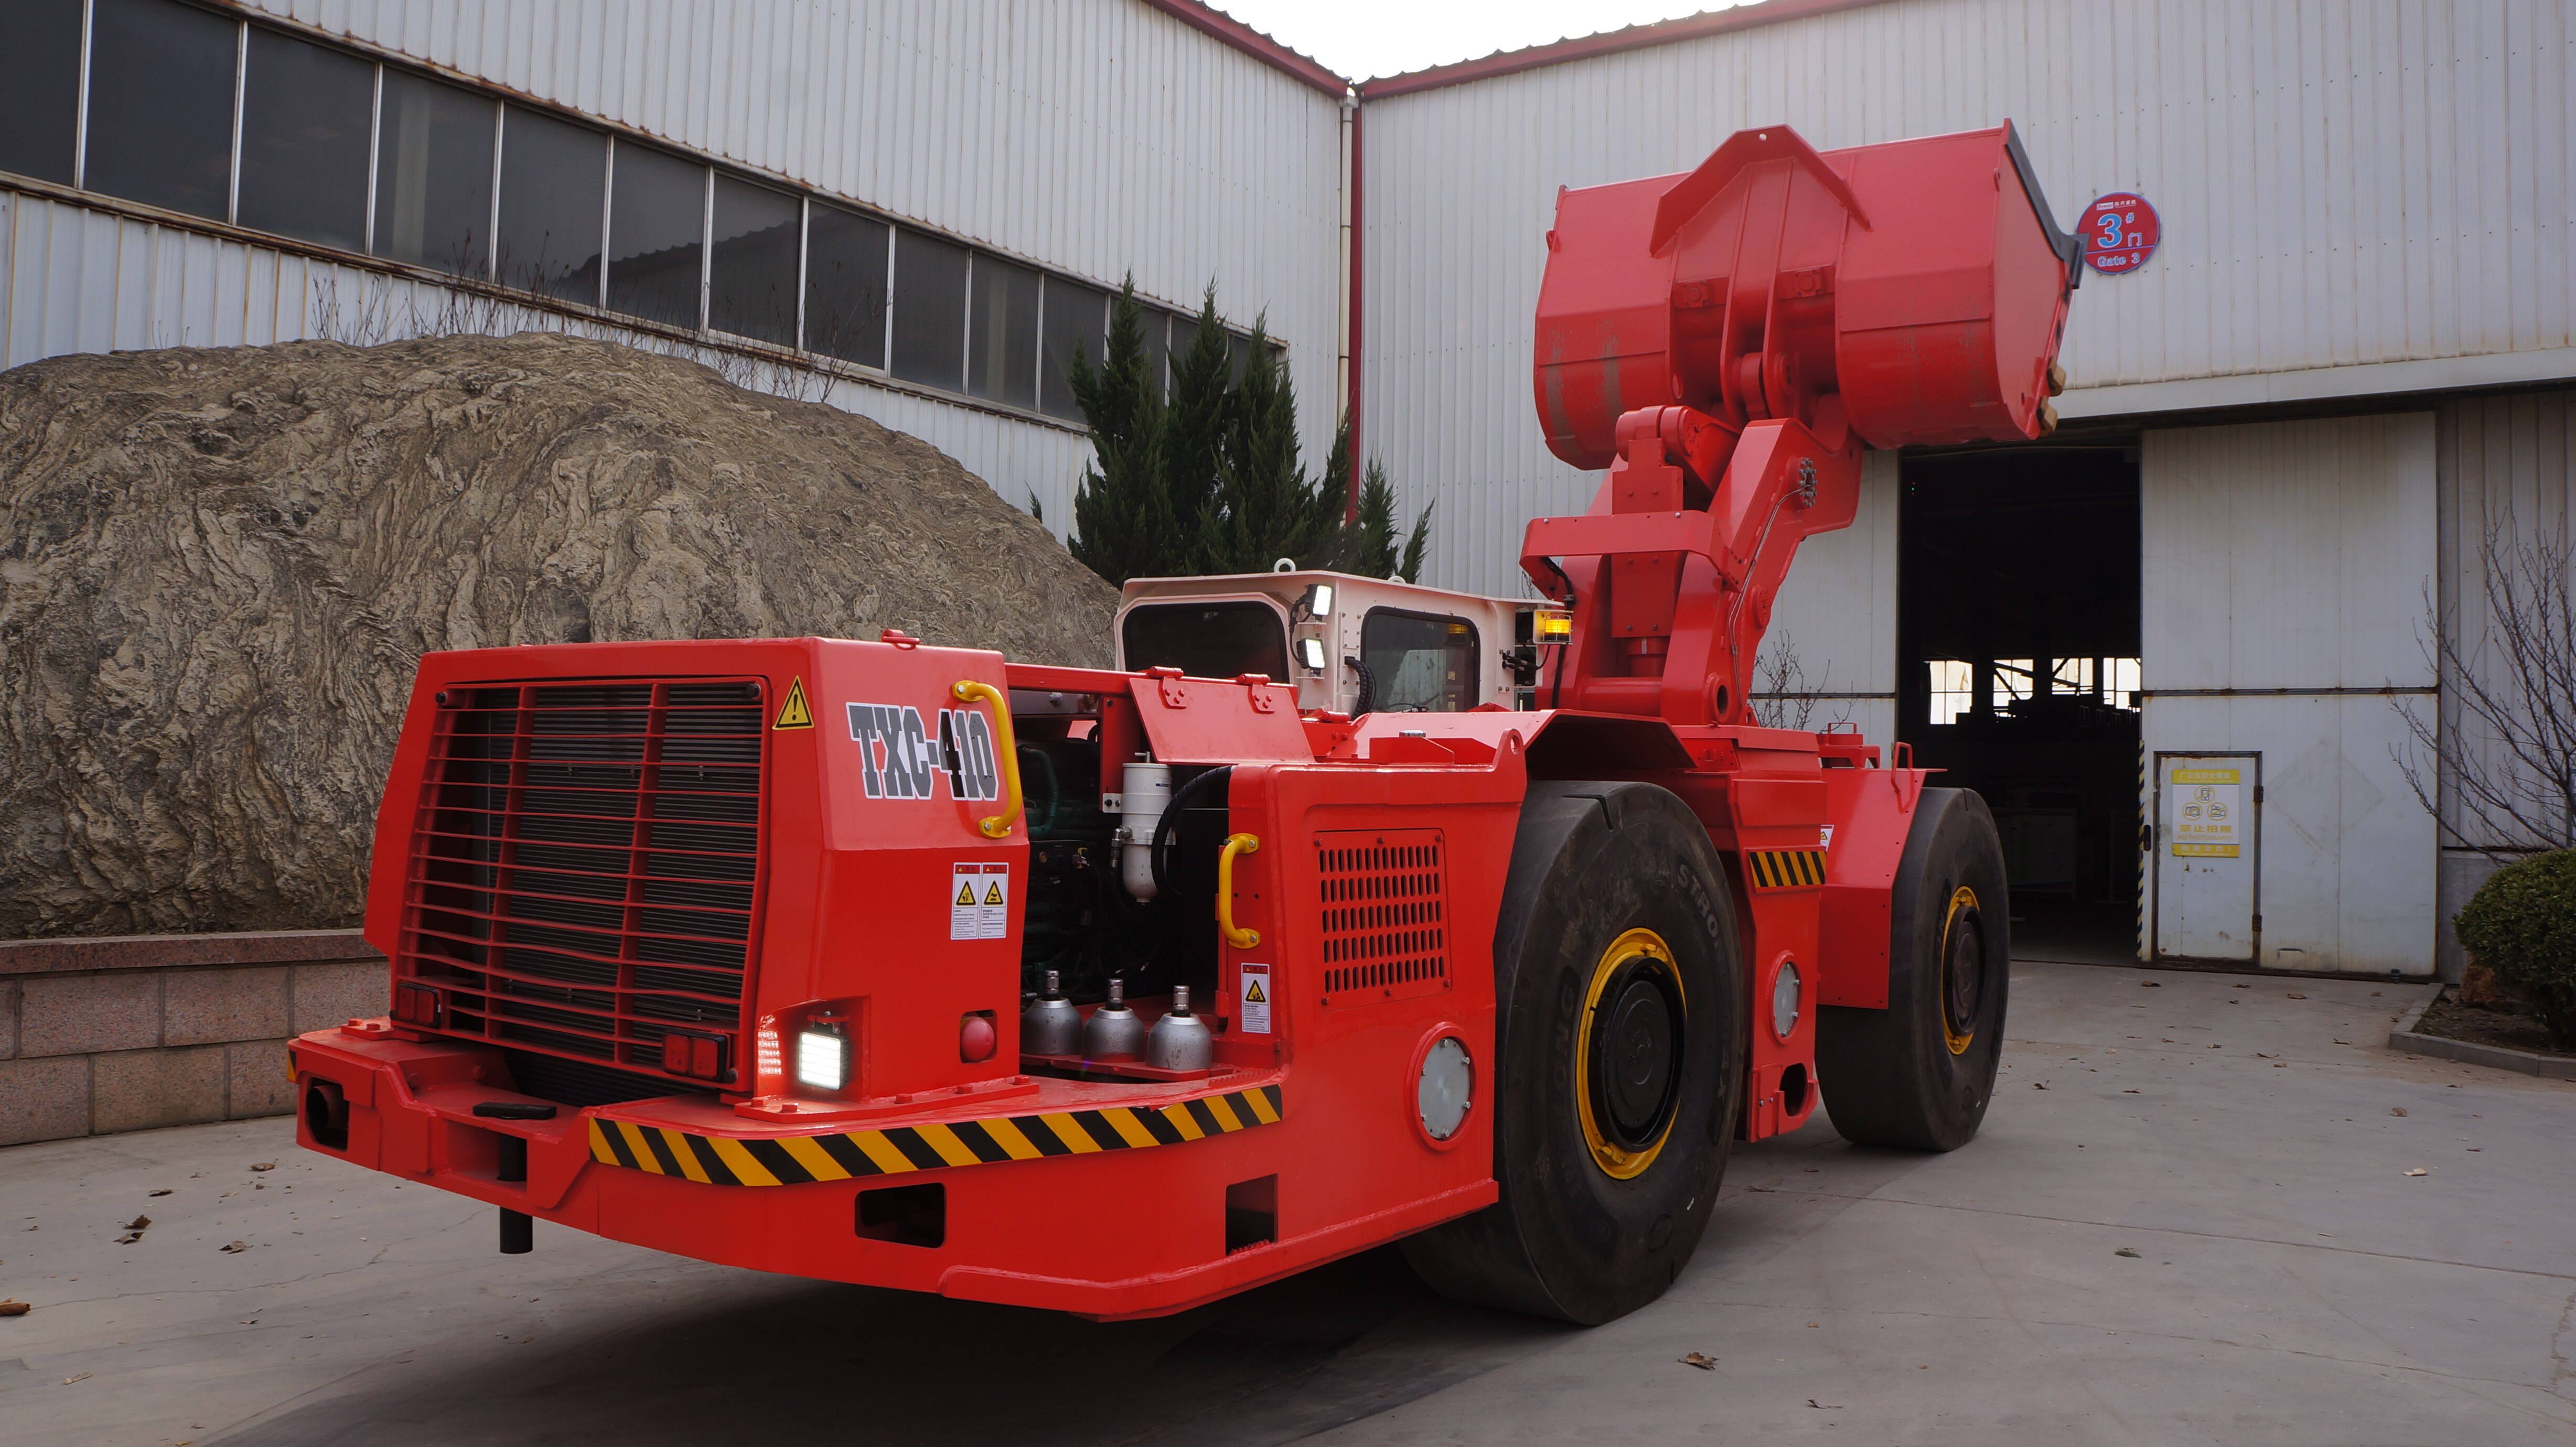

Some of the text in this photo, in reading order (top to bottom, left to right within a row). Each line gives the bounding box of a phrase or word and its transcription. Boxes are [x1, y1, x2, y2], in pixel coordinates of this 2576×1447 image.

[2098, 253, 2140, 267] Gate 3
[845, 701, 999, 801] TXC-410
